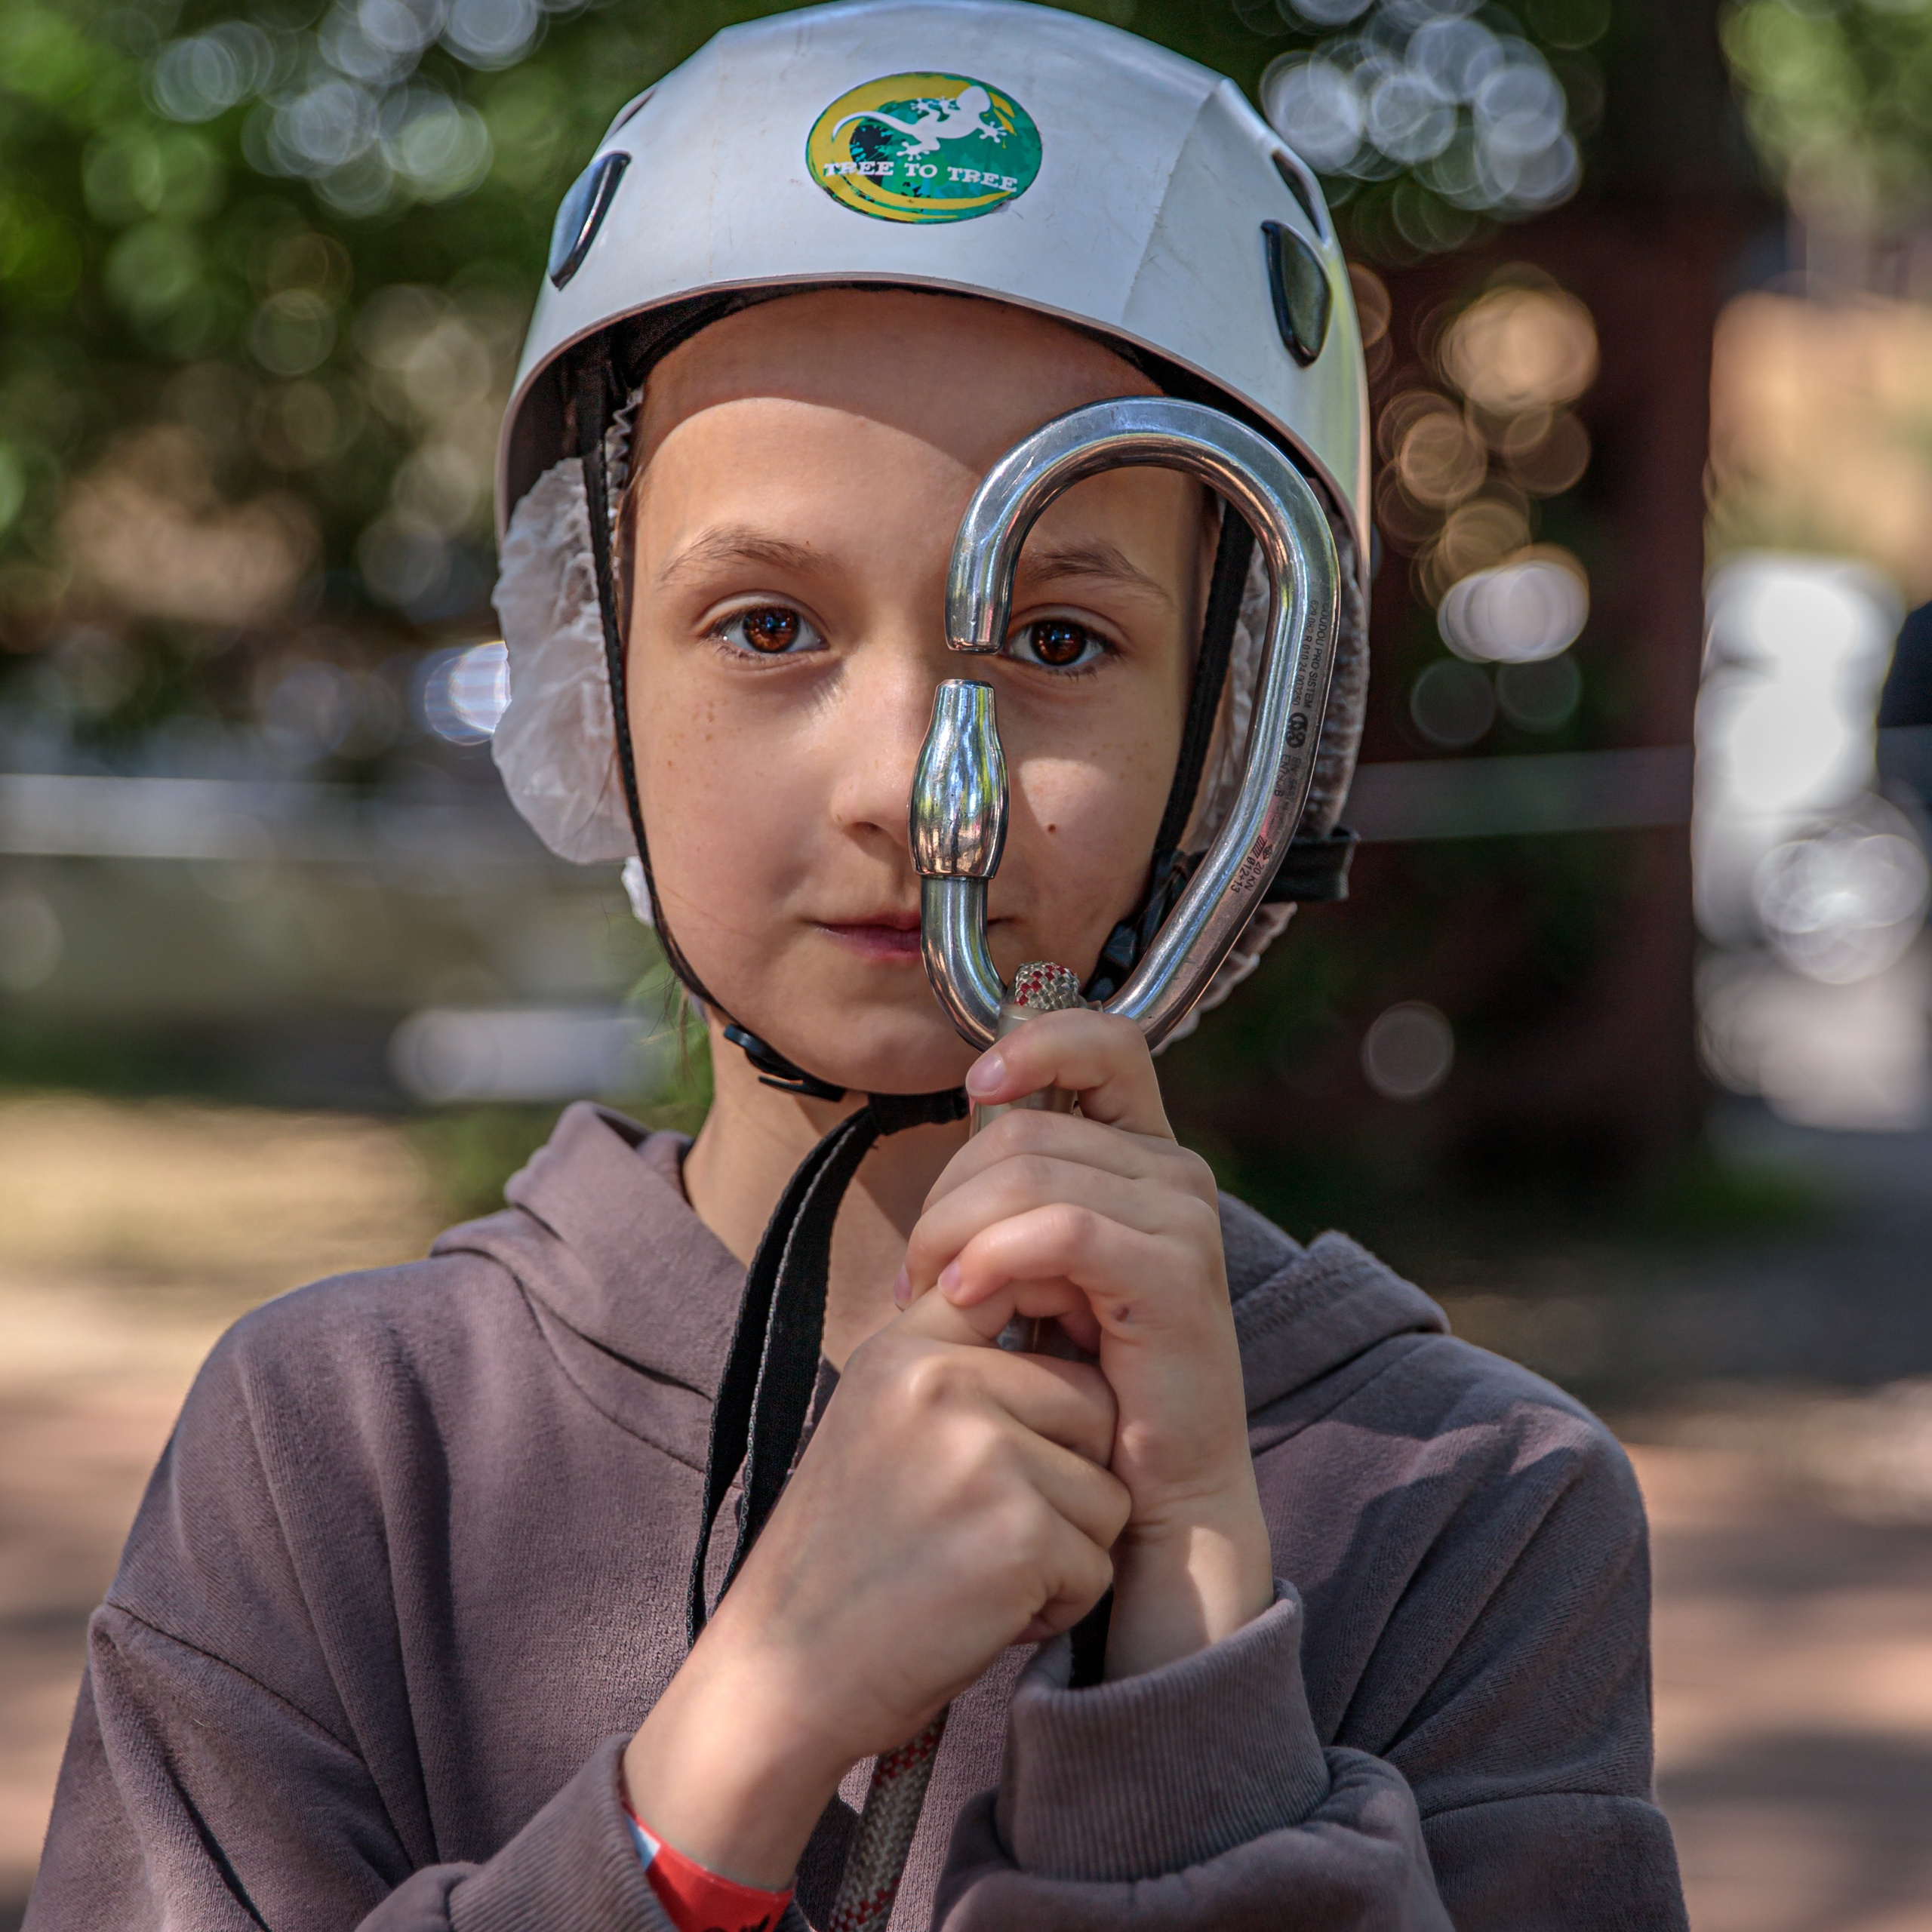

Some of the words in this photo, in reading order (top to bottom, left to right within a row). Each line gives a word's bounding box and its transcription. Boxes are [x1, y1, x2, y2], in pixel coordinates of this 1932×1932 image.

[823, 161, 894, 177] TREE
[904, 163, 938, 178] TO
[947, 165, 1017, 192] TREE
[1300, 644, 1311, 660] 010
[1310, 647, 1323, 669] PRO
[1298, 661, 1308, 672] 24
[1291, 674, 1305, 706] 003250
[1303, 671, 1318, 709] SISTEM
[1253, 861, 1265, 875] 20
[1244, 874, 1258, 892] KN
